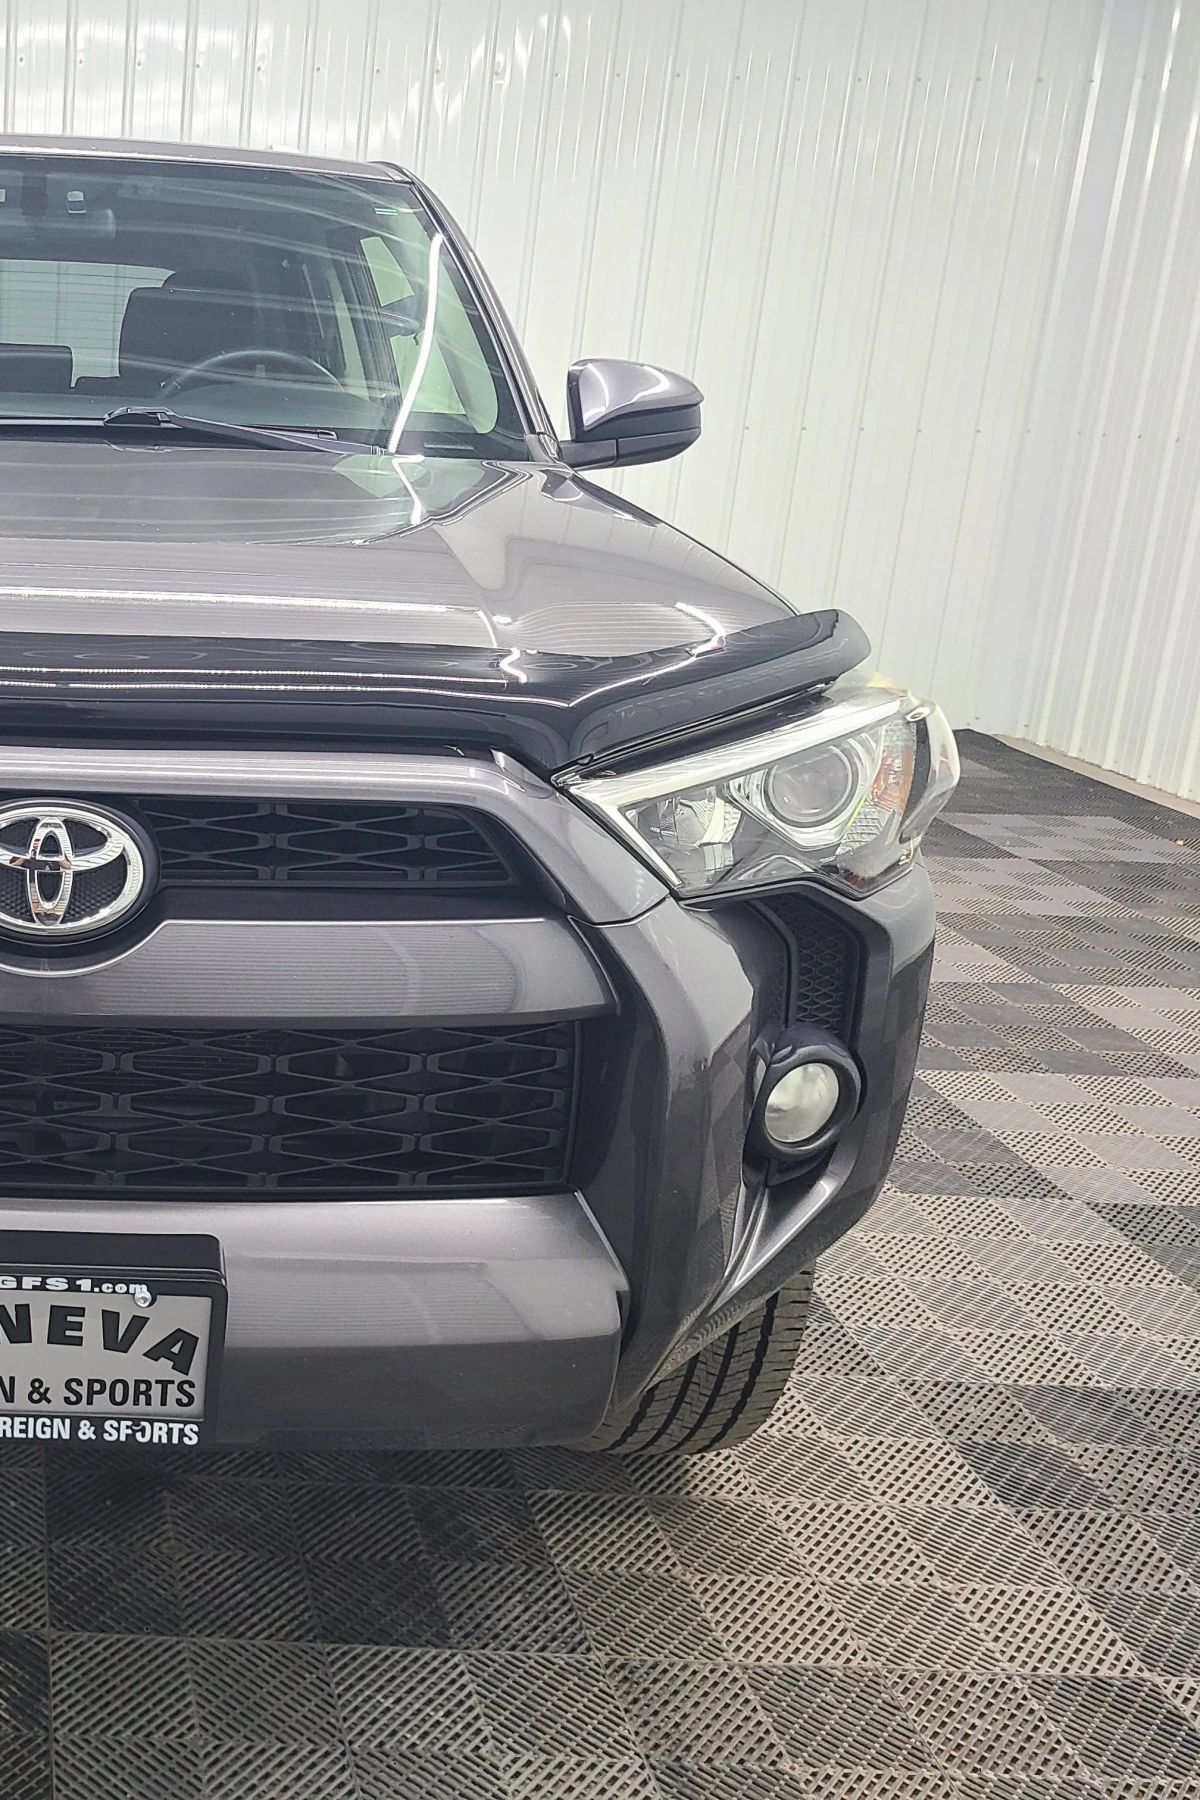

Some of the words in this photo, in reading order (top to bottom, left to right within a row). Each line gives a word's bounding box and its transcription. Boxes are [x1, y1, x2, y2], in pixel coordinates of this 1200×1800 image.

[27, 1377, 52, 1405] &
[63, 1377, 196, 1407] SPORTS
[77, 1419, 97, 1441] &
